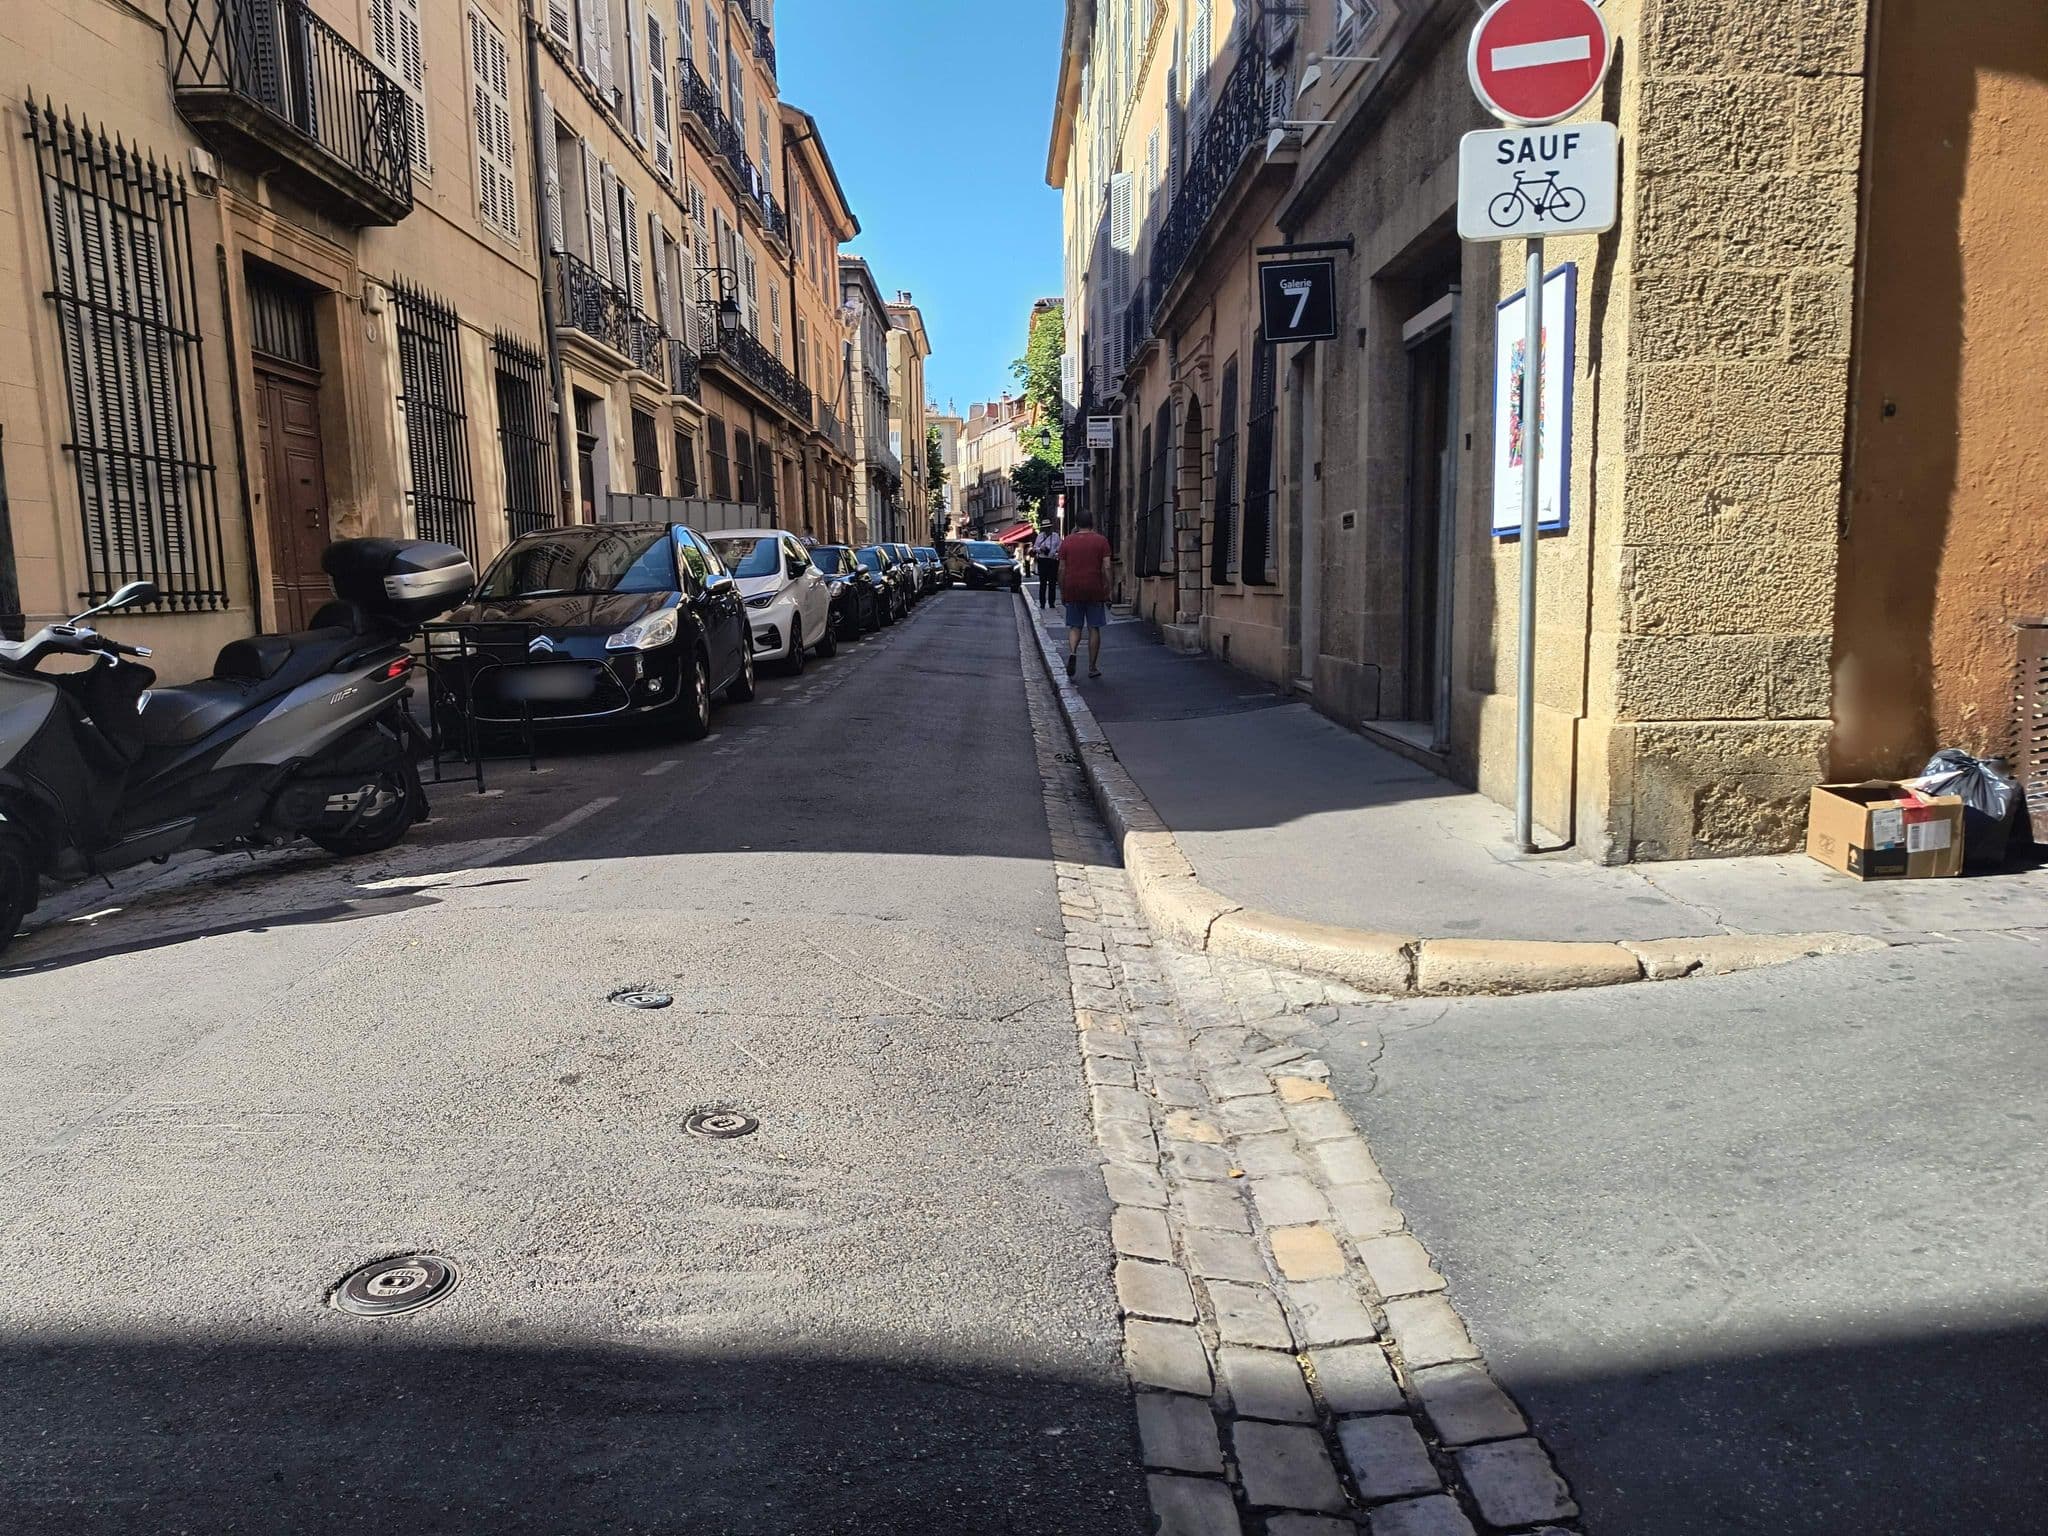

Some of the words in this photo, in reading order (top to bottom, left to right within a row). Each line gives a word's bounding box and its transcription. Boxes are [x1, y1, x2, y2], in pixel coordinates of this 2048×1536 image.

[1496, 133, 1580, 164] SAUF
[1279, 278, 1312, 289] Galerie
[1283, 287, 1310, 329] 7
